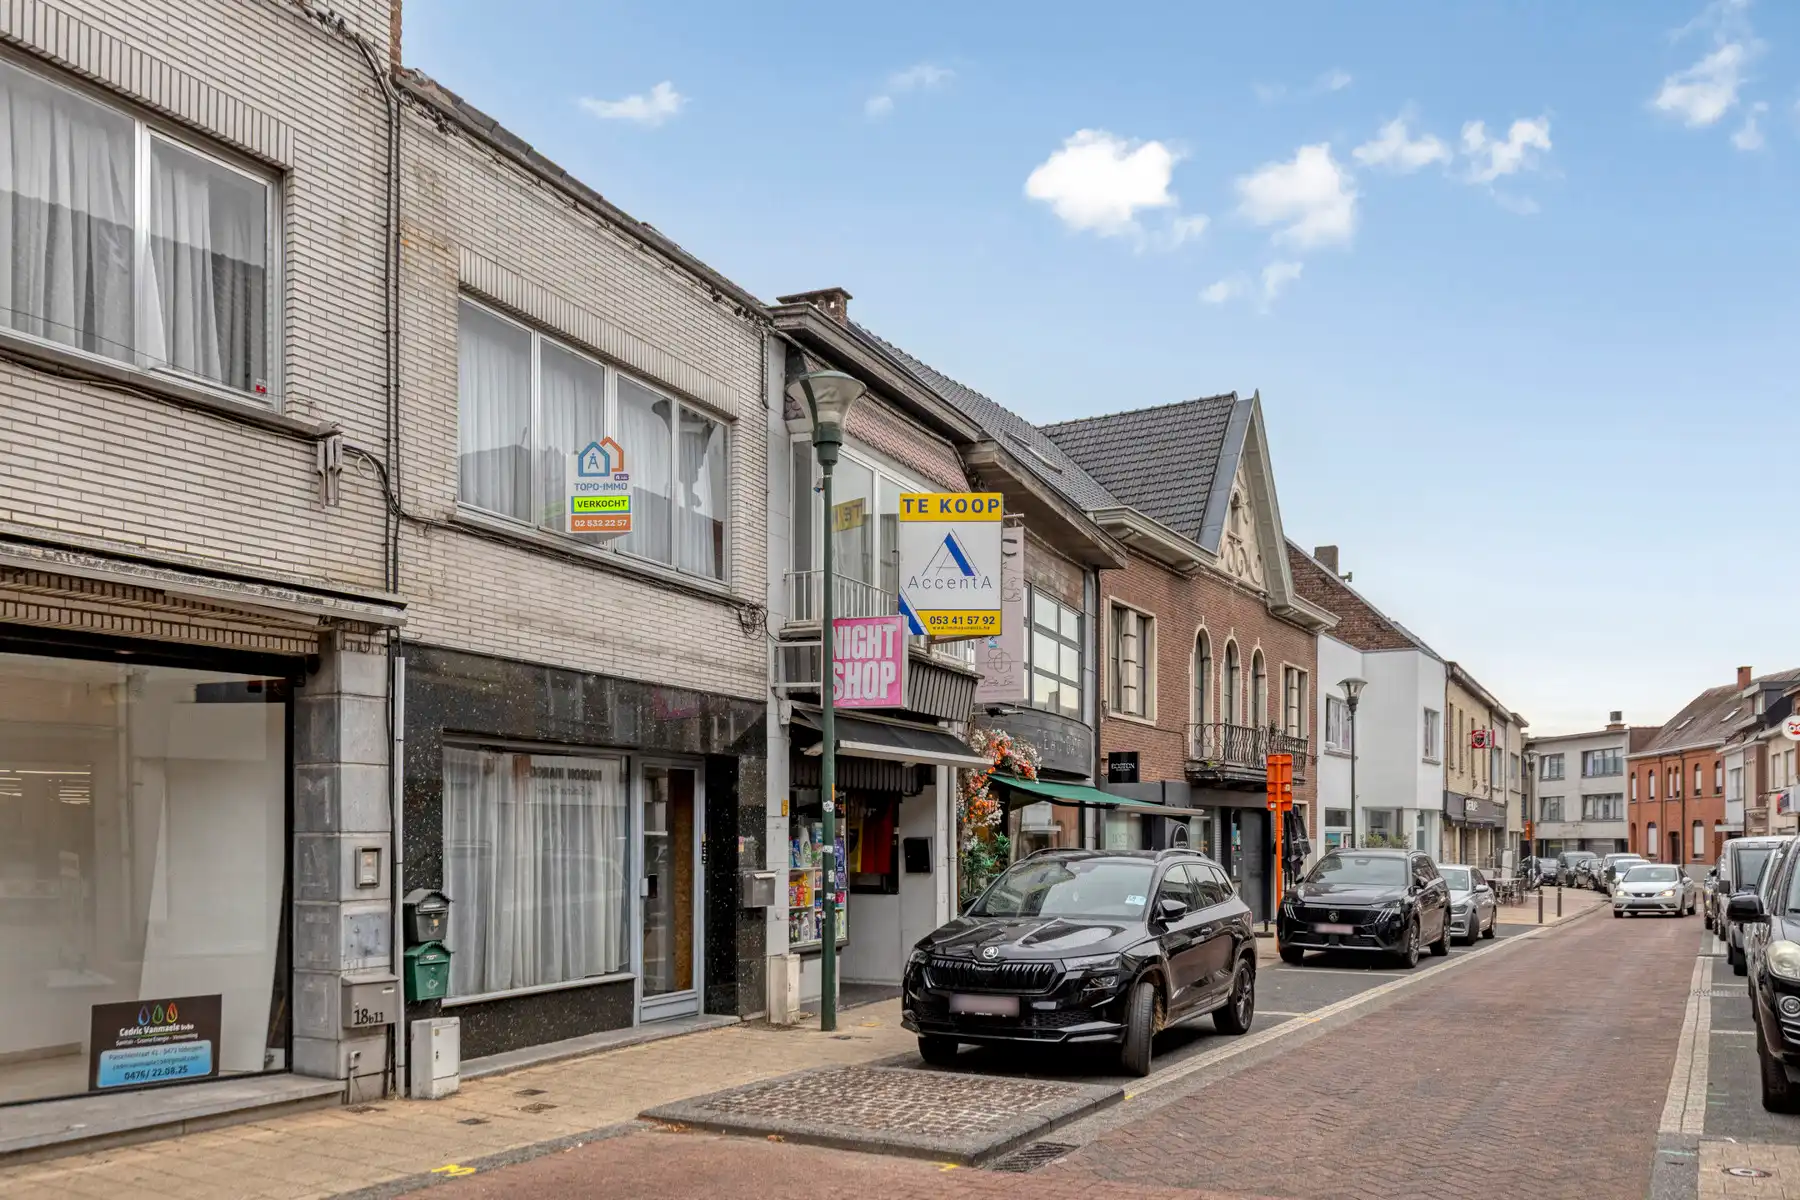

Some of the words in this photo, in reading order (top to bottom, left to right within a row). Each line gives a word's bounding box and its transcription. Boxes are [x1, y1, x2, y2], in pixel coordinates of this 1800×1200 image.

[574, 482, 628, 491] TOPO-IMMO
[577, 499, 627, 508] VERKOCHT
[902, 498, 929, 514] TE
[939, 498, 1000, 514] KOOP
[574, 519, 585, 527] 02
[605, 519, 616, 527] 22
[617, 519, 628, 527] 57
[907, 575, 993, 590] AccentA
[929, 616, 949, 625] 053
[951, 616, 964, 625] 41
[967, 616, 980, 625] 57
[982, 616, 996, 625] 92
[119, 1026, 143, 1037] Cedric
